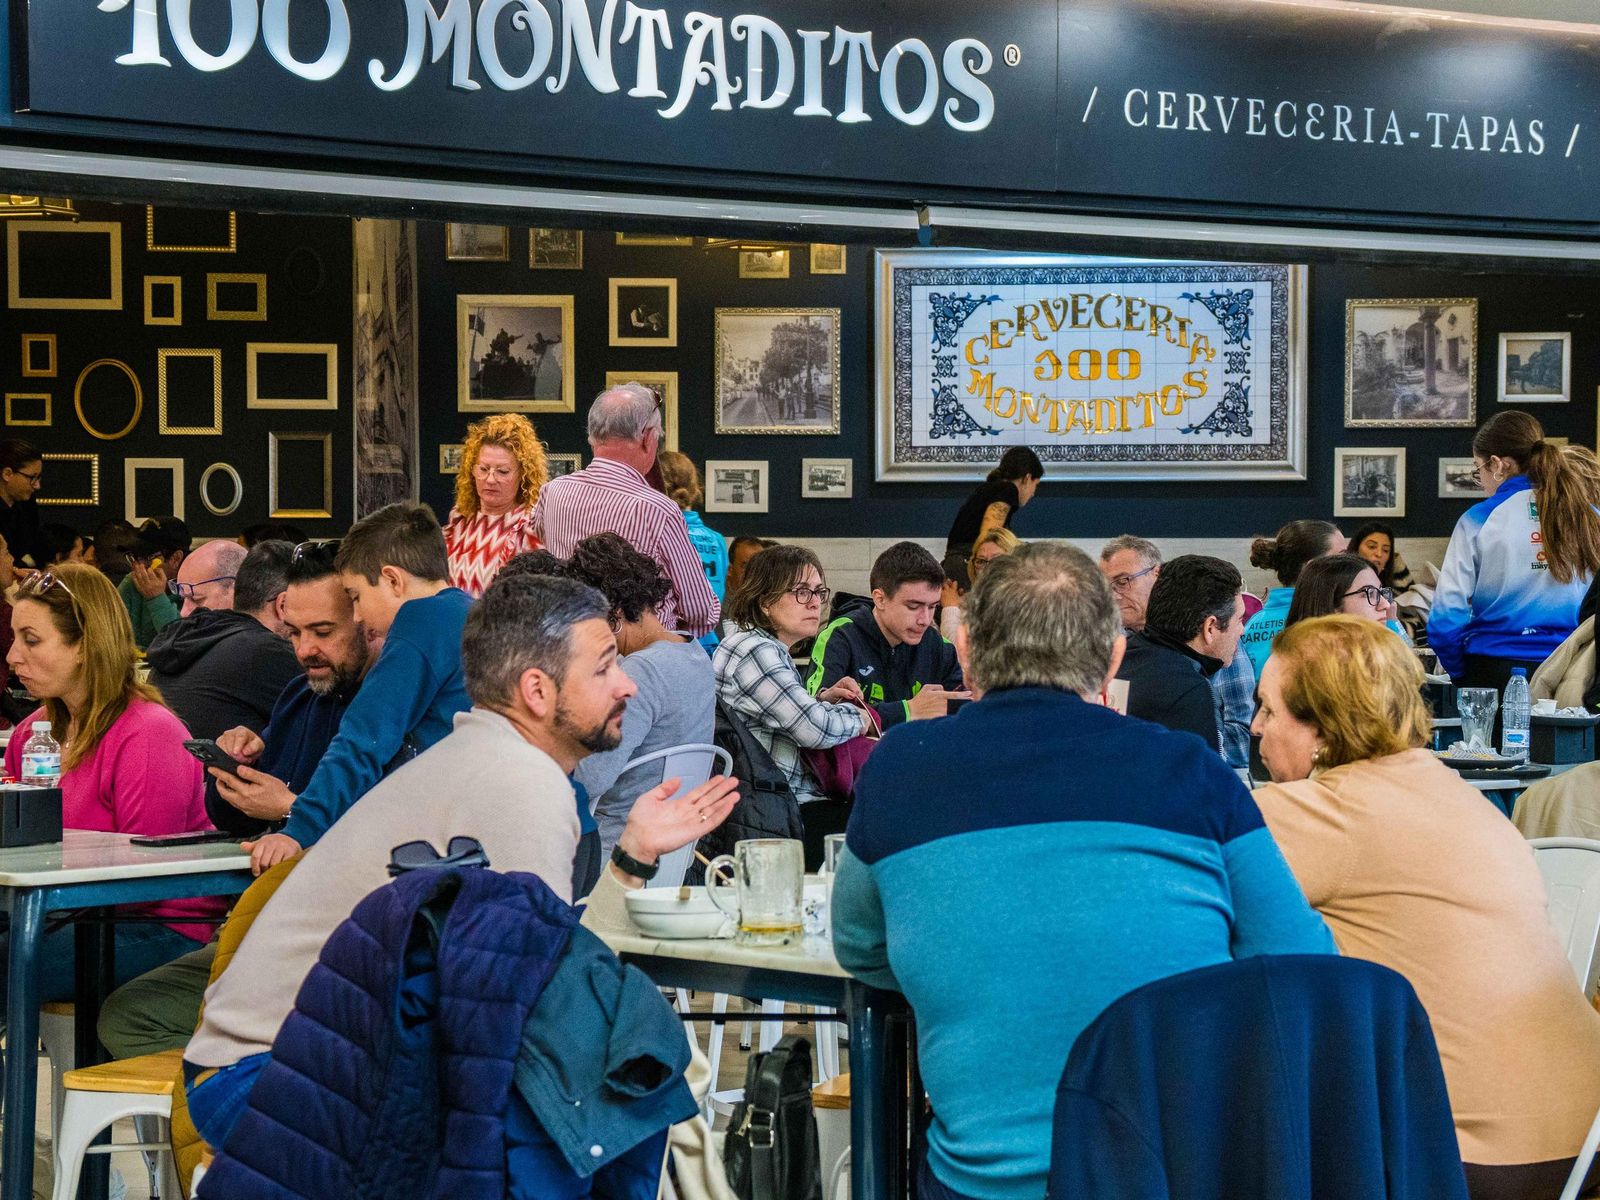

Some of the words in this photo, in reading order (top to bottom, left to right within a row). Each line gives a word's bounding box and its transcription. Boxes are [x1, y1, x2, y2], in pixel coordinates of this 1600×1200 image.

[97, 0, 350, 81] 100
[368, 0, 995, 132] MONTADITOS
[964, 293, 1216, 366] CERVECERIA
[965, 368, 1208, 435] MONTADITOS
